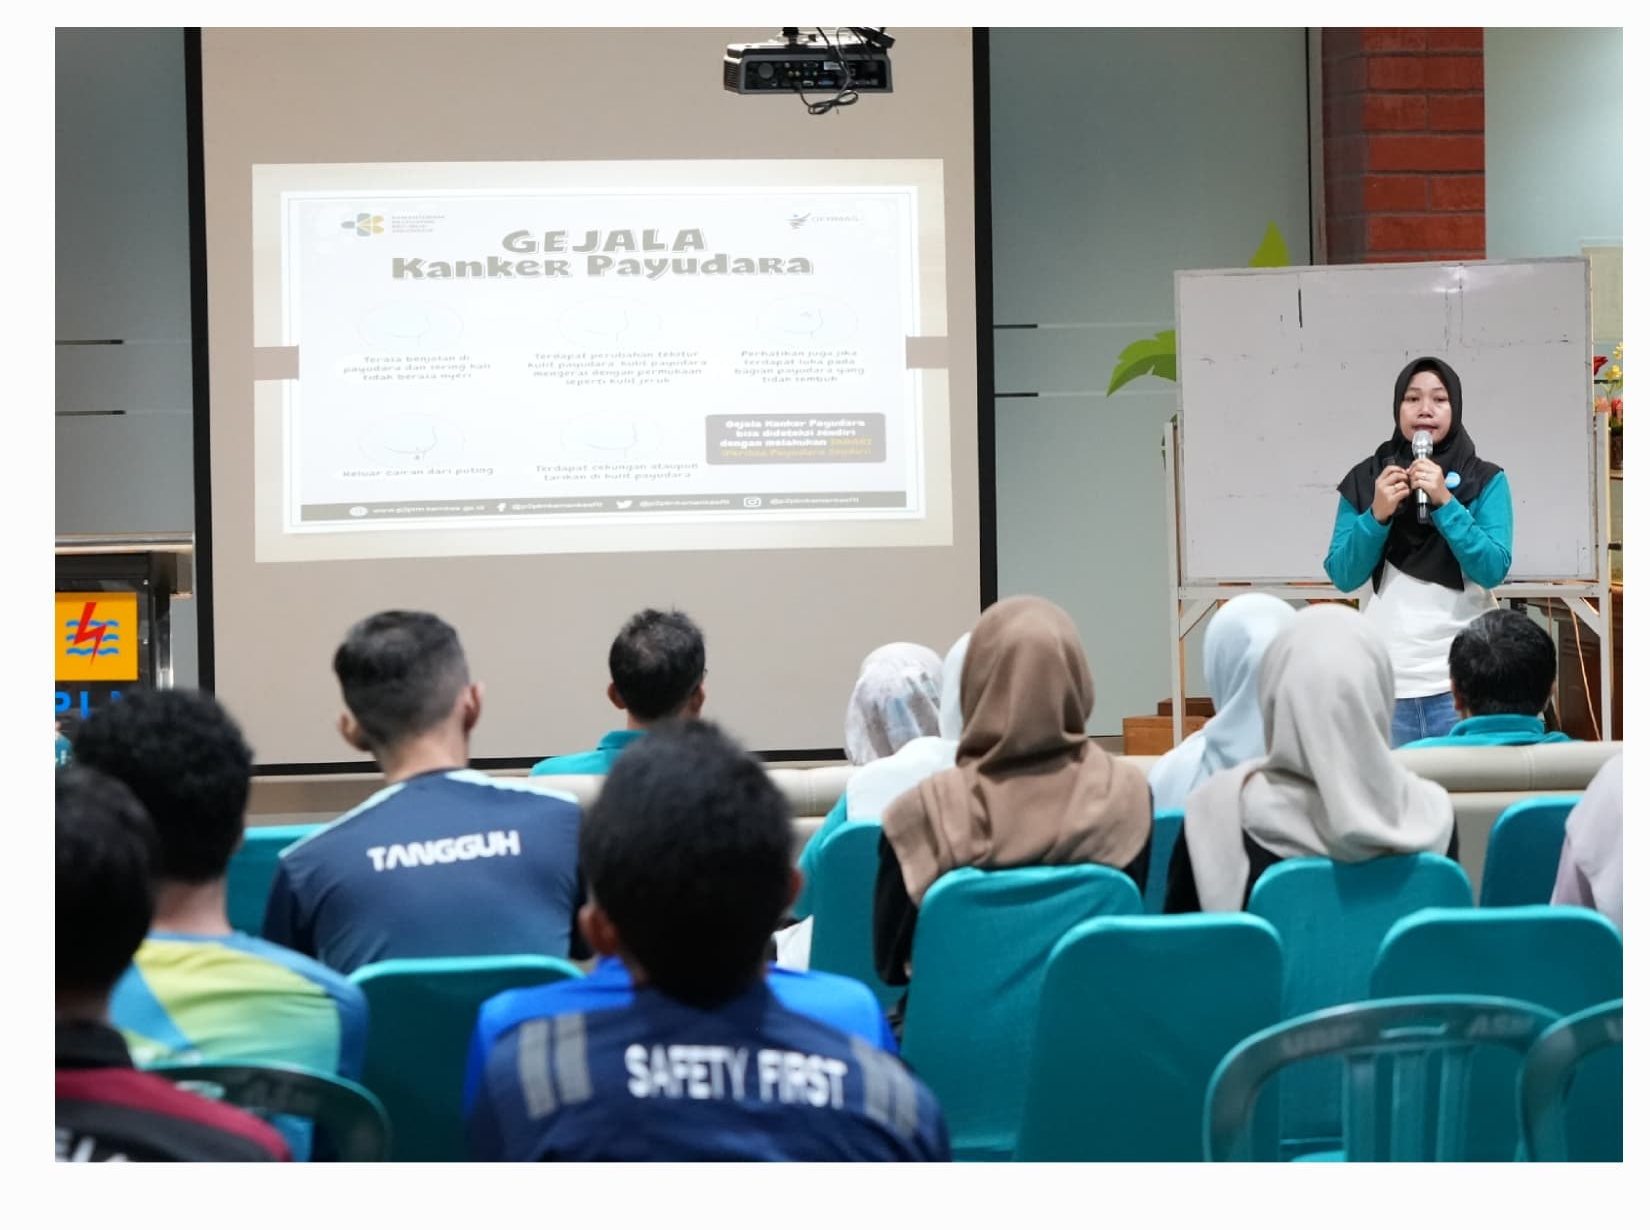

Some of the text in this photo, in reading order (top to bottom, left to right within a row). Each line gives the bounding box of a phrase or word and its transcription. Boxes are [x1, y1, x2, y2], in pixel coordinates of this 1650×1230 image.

[502, 229, 709, 254] GEJALA
[536, 352, 586, 361] Terdapat
[590, 351, 653, 360] perubahan
[741, 350, 805, 358] Perhatikan
[650, 358, 707, 368] payudara
[744, 358, 795, 367] terdapat
[827, 358, 856, 366] pada
[344, 364, 401, 374] payudara
[405, 363, 426, 371] dan
[591, 369, 634, 378] dengan
[637, 368, 702, 377] permukaan
[777, 366, 833, 375] payudara
[363, 373, 392, 381] tidak
[639, 377, 670, 386] jeruk
[795, 375, 838, 383] sembuh
[725, 420, 762, 430] Gejala
[809, 419, 866, 429] Payudara
[736, 428, 856, 437] bisa dideteksi sendiri
[719, 439, 762, 449] dengan
[765, 438, 826, 446] melakukan
[455, 467, 494, 476] puting
[592, 464, 647, 472] cekungan
[634, 472, 692, 481] payudara
[366, 830, 520, 871] TANGGUH
[625, 1044, 848, 1108] SAFETY FIRST
